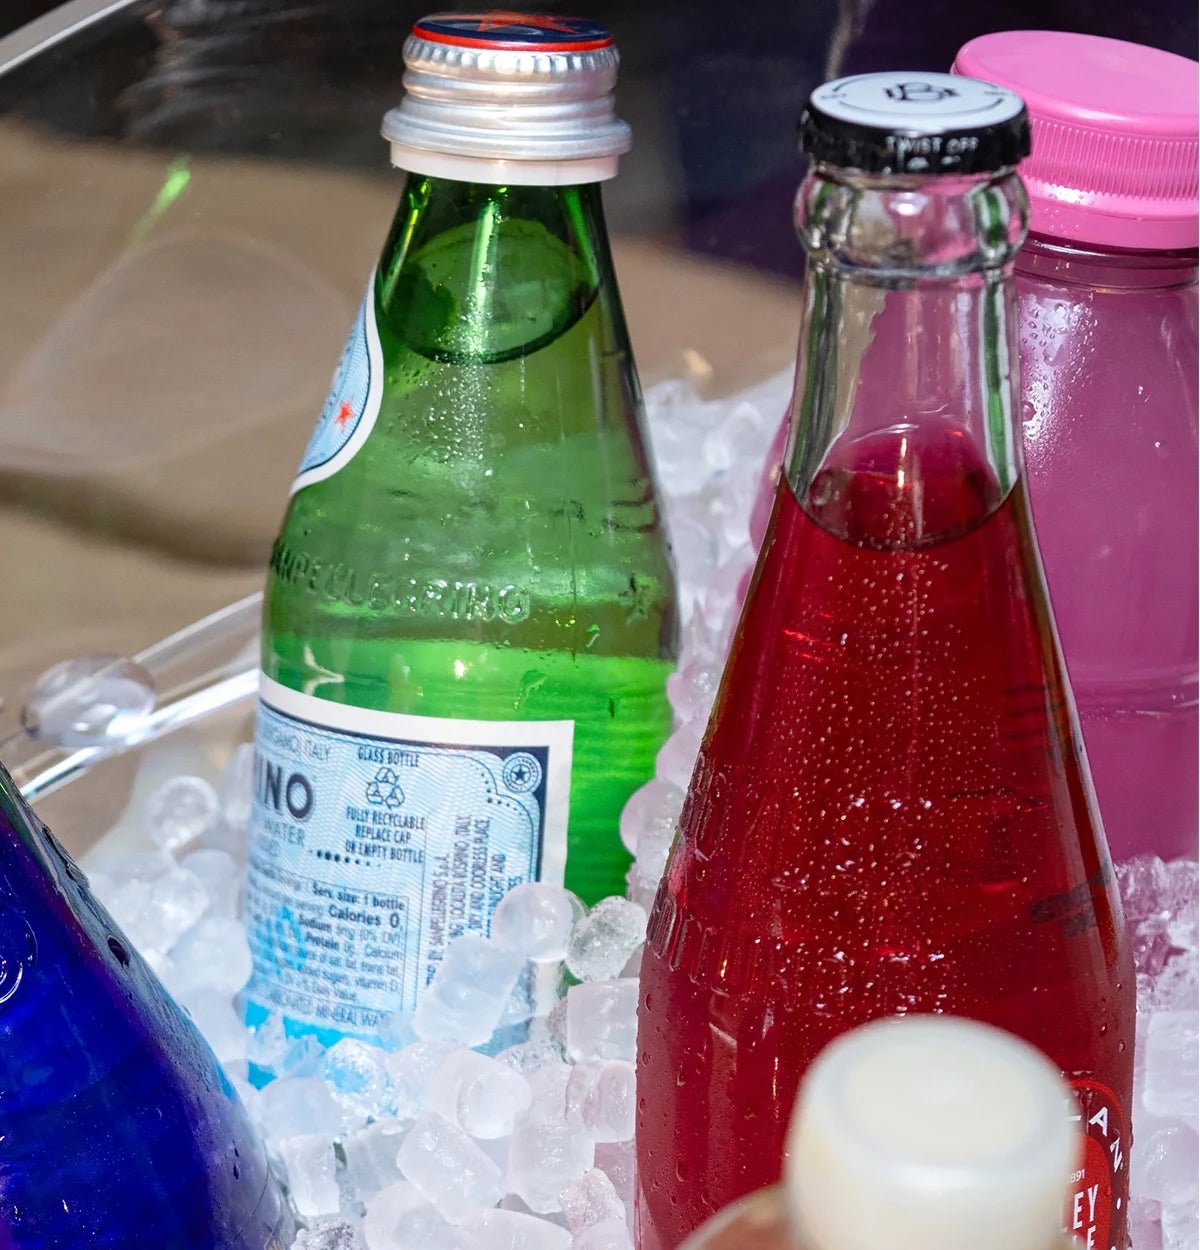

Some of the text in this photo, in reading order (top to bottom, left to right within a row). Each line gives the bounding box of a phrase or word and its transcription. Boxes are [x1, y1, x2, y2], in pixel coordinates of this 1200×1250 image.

[884, 136, 979, 154] TWIST OFF
[358, 745, 420, 768] GLASS BOTTLE
[346, 805, 426, 831] FULLY RECYCLABLE
[355, 824, 412, 845] REPLACE CAP
[358, 841, 388, 859] EMPTY
[390, 847, 425, 864] BOTTLE
[372, 896, 405, 912] bottle
[299, 913, 333, 933] Sodium
[328, 904, 382, 926] Calories
[306, 931, 340, 951] Protein
